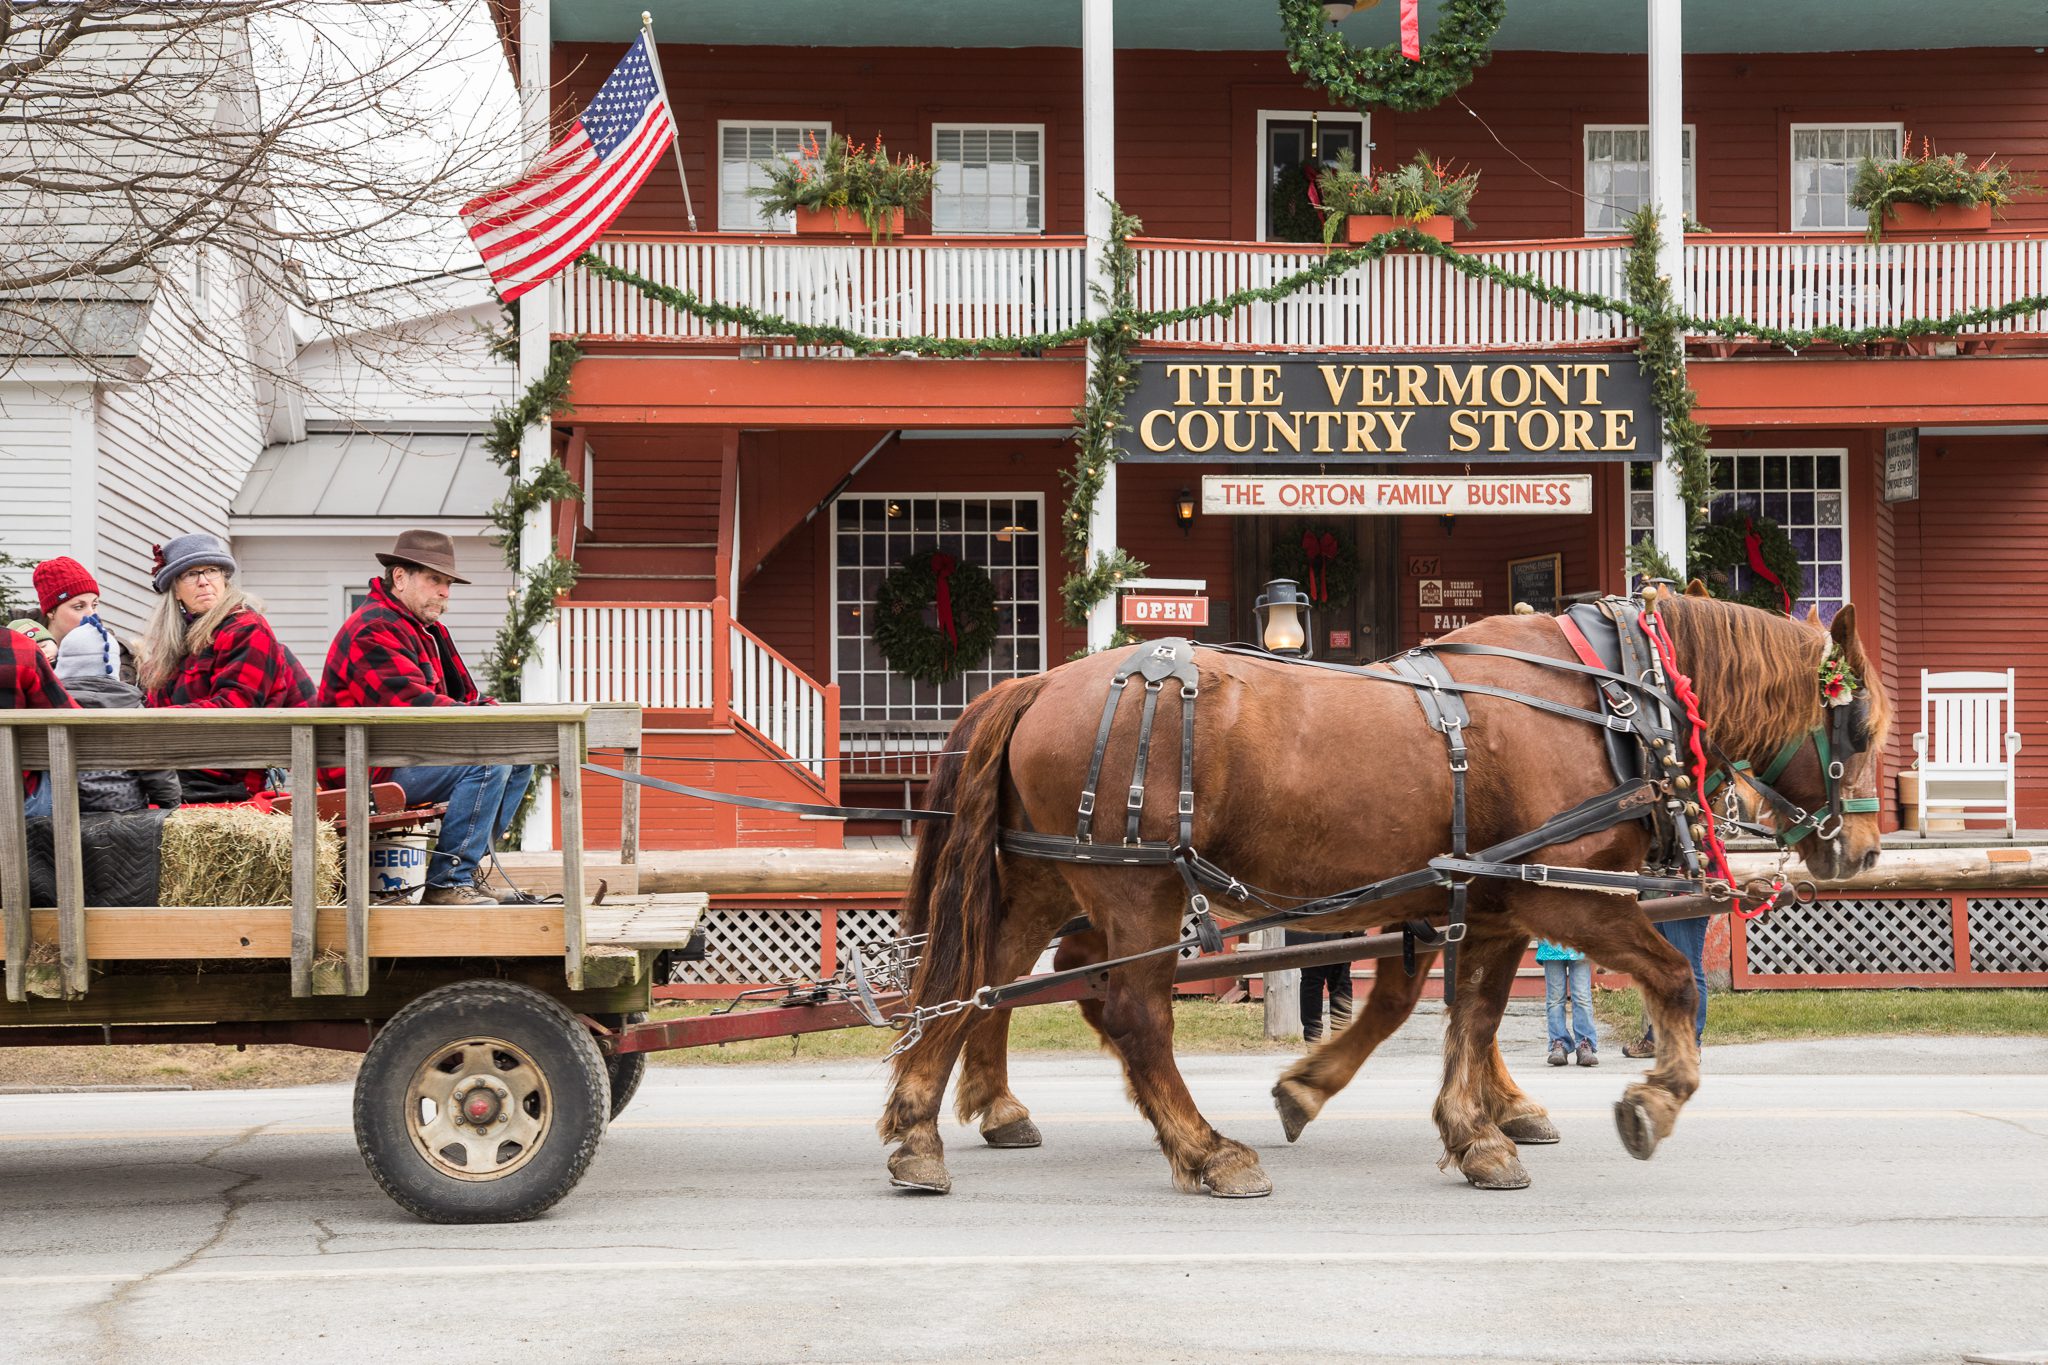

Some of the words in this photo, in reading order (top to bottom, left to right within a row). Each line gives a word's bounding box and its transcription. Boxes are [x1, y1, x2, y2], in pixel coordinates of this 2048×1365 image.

[1166, 364, 1283, 406] THE
[1319, 364, 1609, 407] VERMONT
[1139, 409, 1415, 453] COUNTRY
[1449, 409, 1636, 452] STORE
[1898, 459, 1911, 471] SYRUP
[1894, 478, 1902, 489] SALE
[1221, 483, 1265, 505] THE
[1279, 483, 1365, 507] ORTON
[1377, 483, 1453, 506] FAMILY
[1467, 483, 1572, 507] BUSINESS
[1411, 558, 1439, 574] 657
[1450, 581, 1474, 589] VERMONT
[1443, 590, 1465, 598] COUNTRY
[1466, 590, 1482, 598] STORE
[1454, 598, 1474, 606] HOURS
[1136, 601, 1194, 620] OPEN
[1434, 615, 1469, 629] FALL
